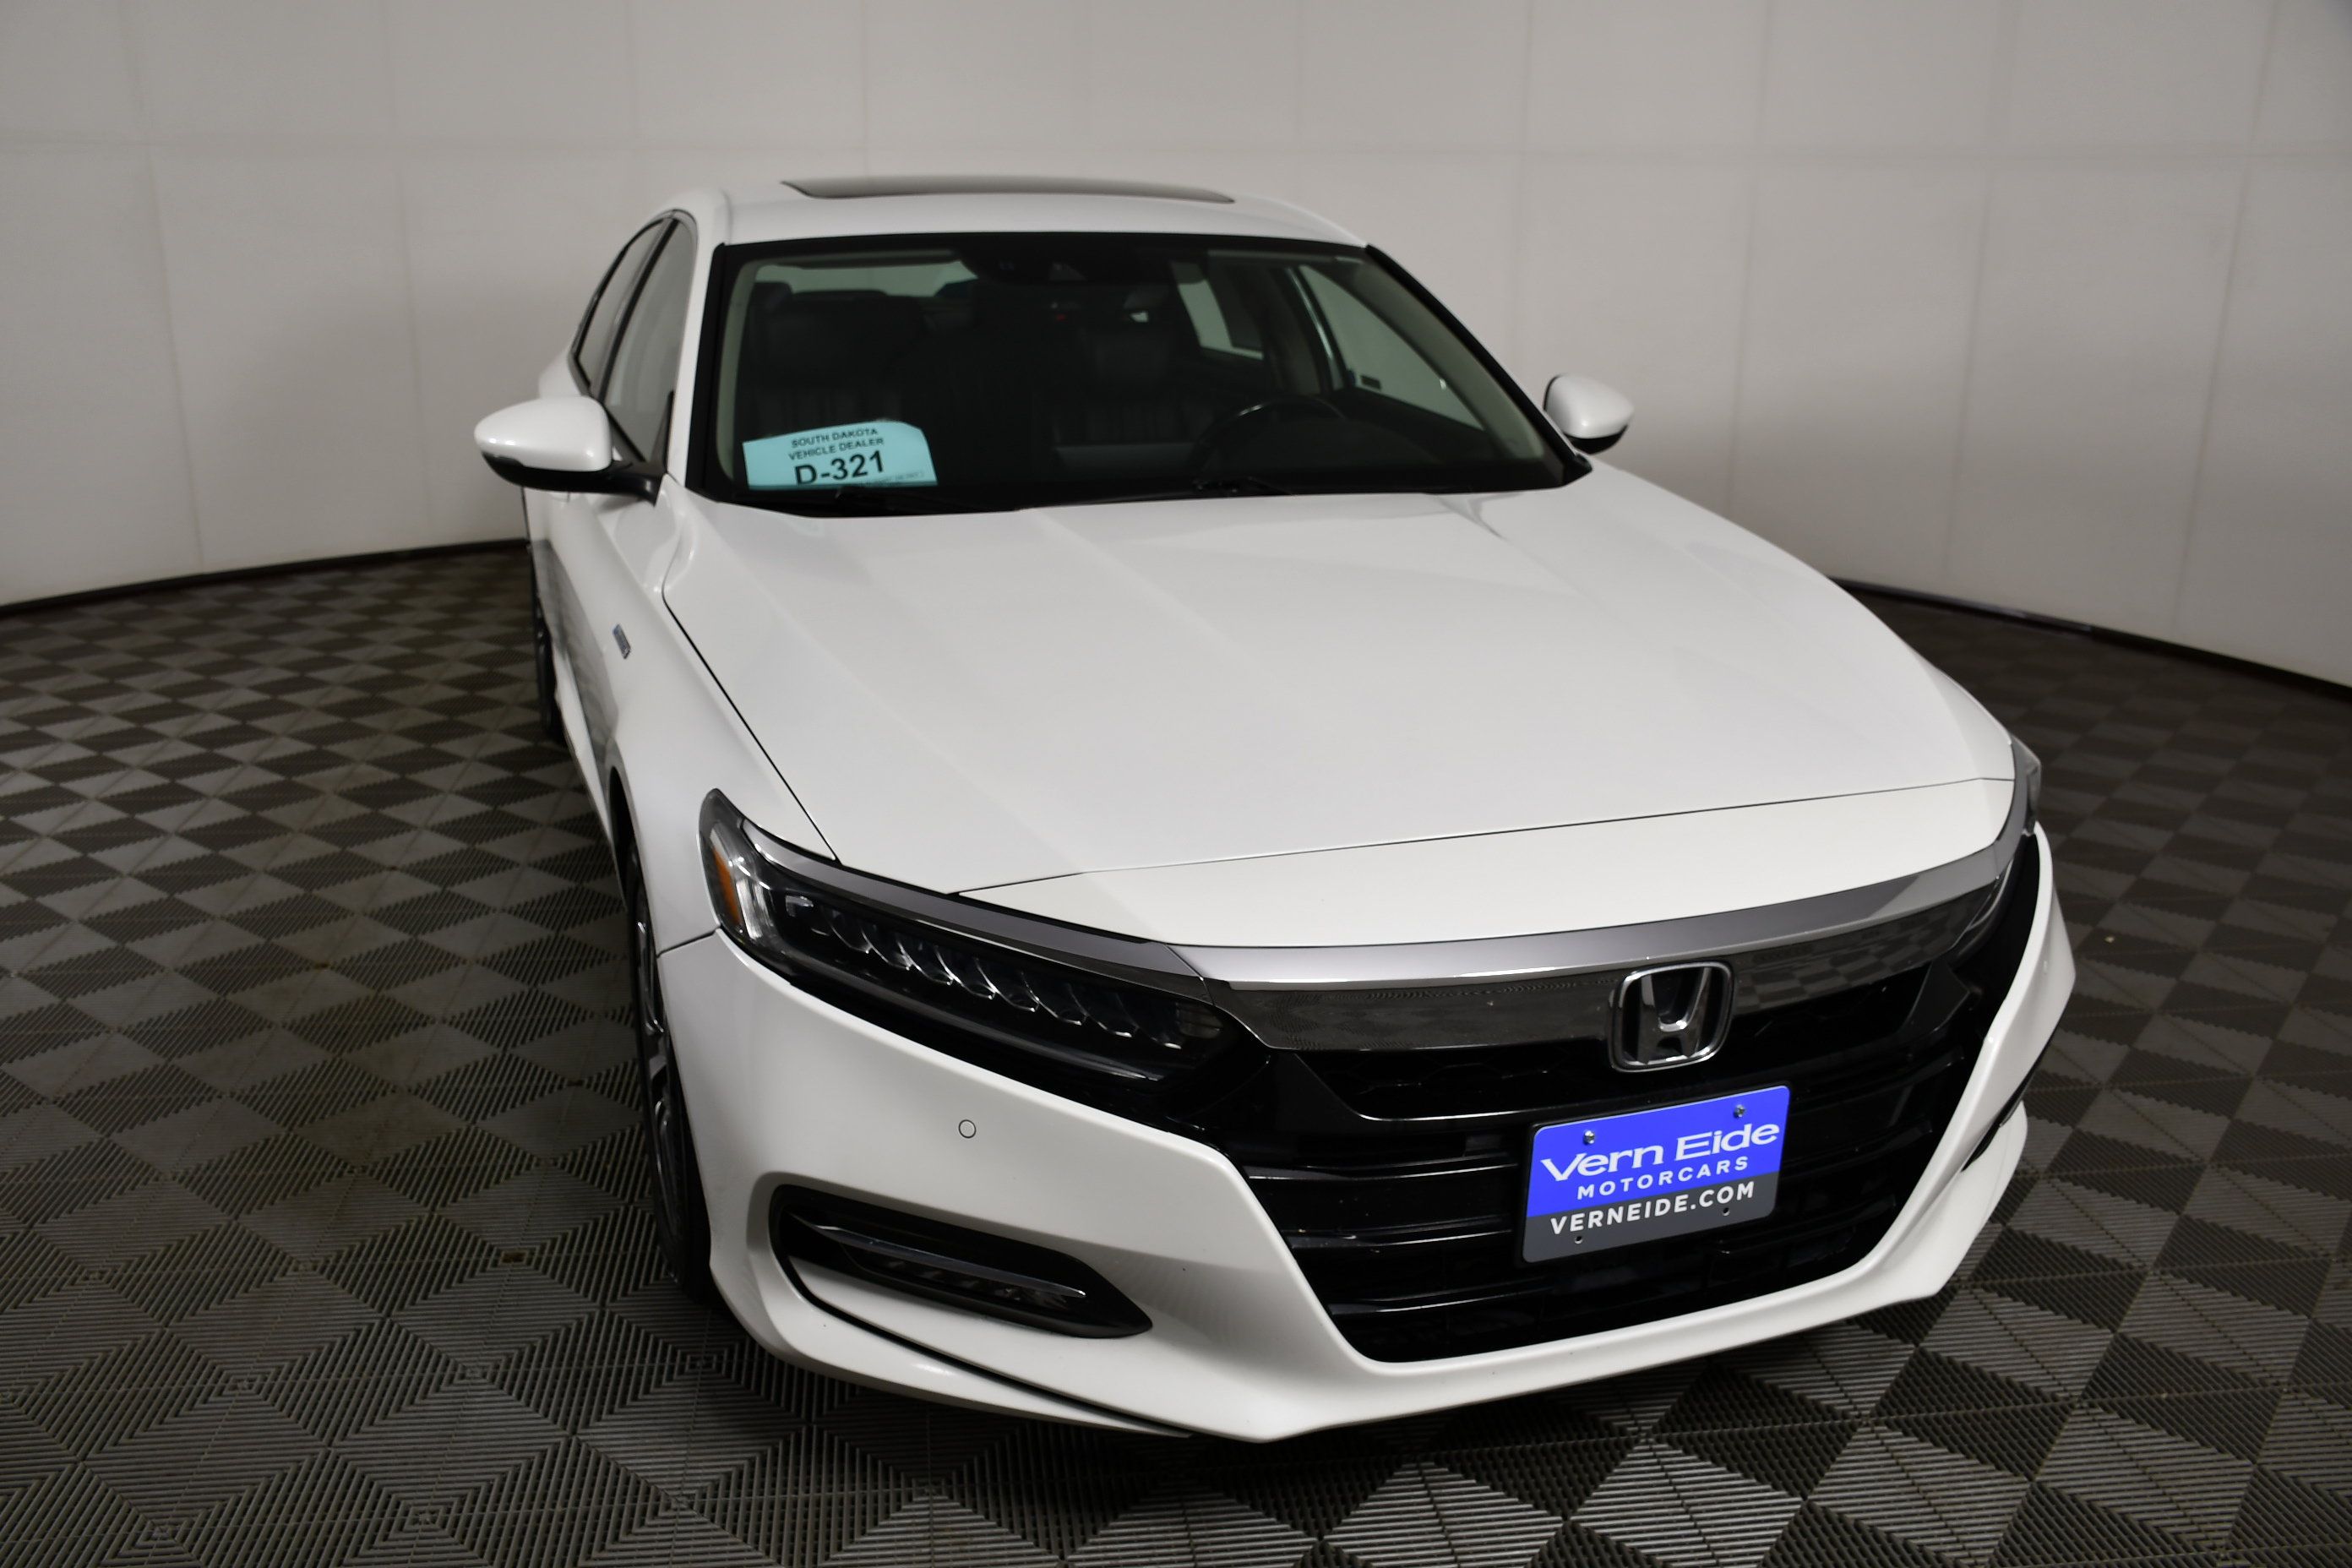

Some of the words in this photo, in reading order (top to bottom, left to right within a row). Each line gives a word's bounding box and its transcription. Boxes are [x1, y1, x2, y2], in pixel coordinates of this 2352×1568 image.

[788, 444, 836, 460] VEHICLE
[839, 437, 884, 450] DEALER
[792, 433, 830, 448] SOUTH
[832, 427, 878, 441] DAKOTA
[795, 450, 884, 484] D-321
[1540, 1143, 1663, 1182] Vern
[1674, 1123, 1780, 1161] Eide
[1576, 1156, 1749, 1200] MOTORCARS
[1549, 1181, 1755, 1235] VERNEIDE.COM
